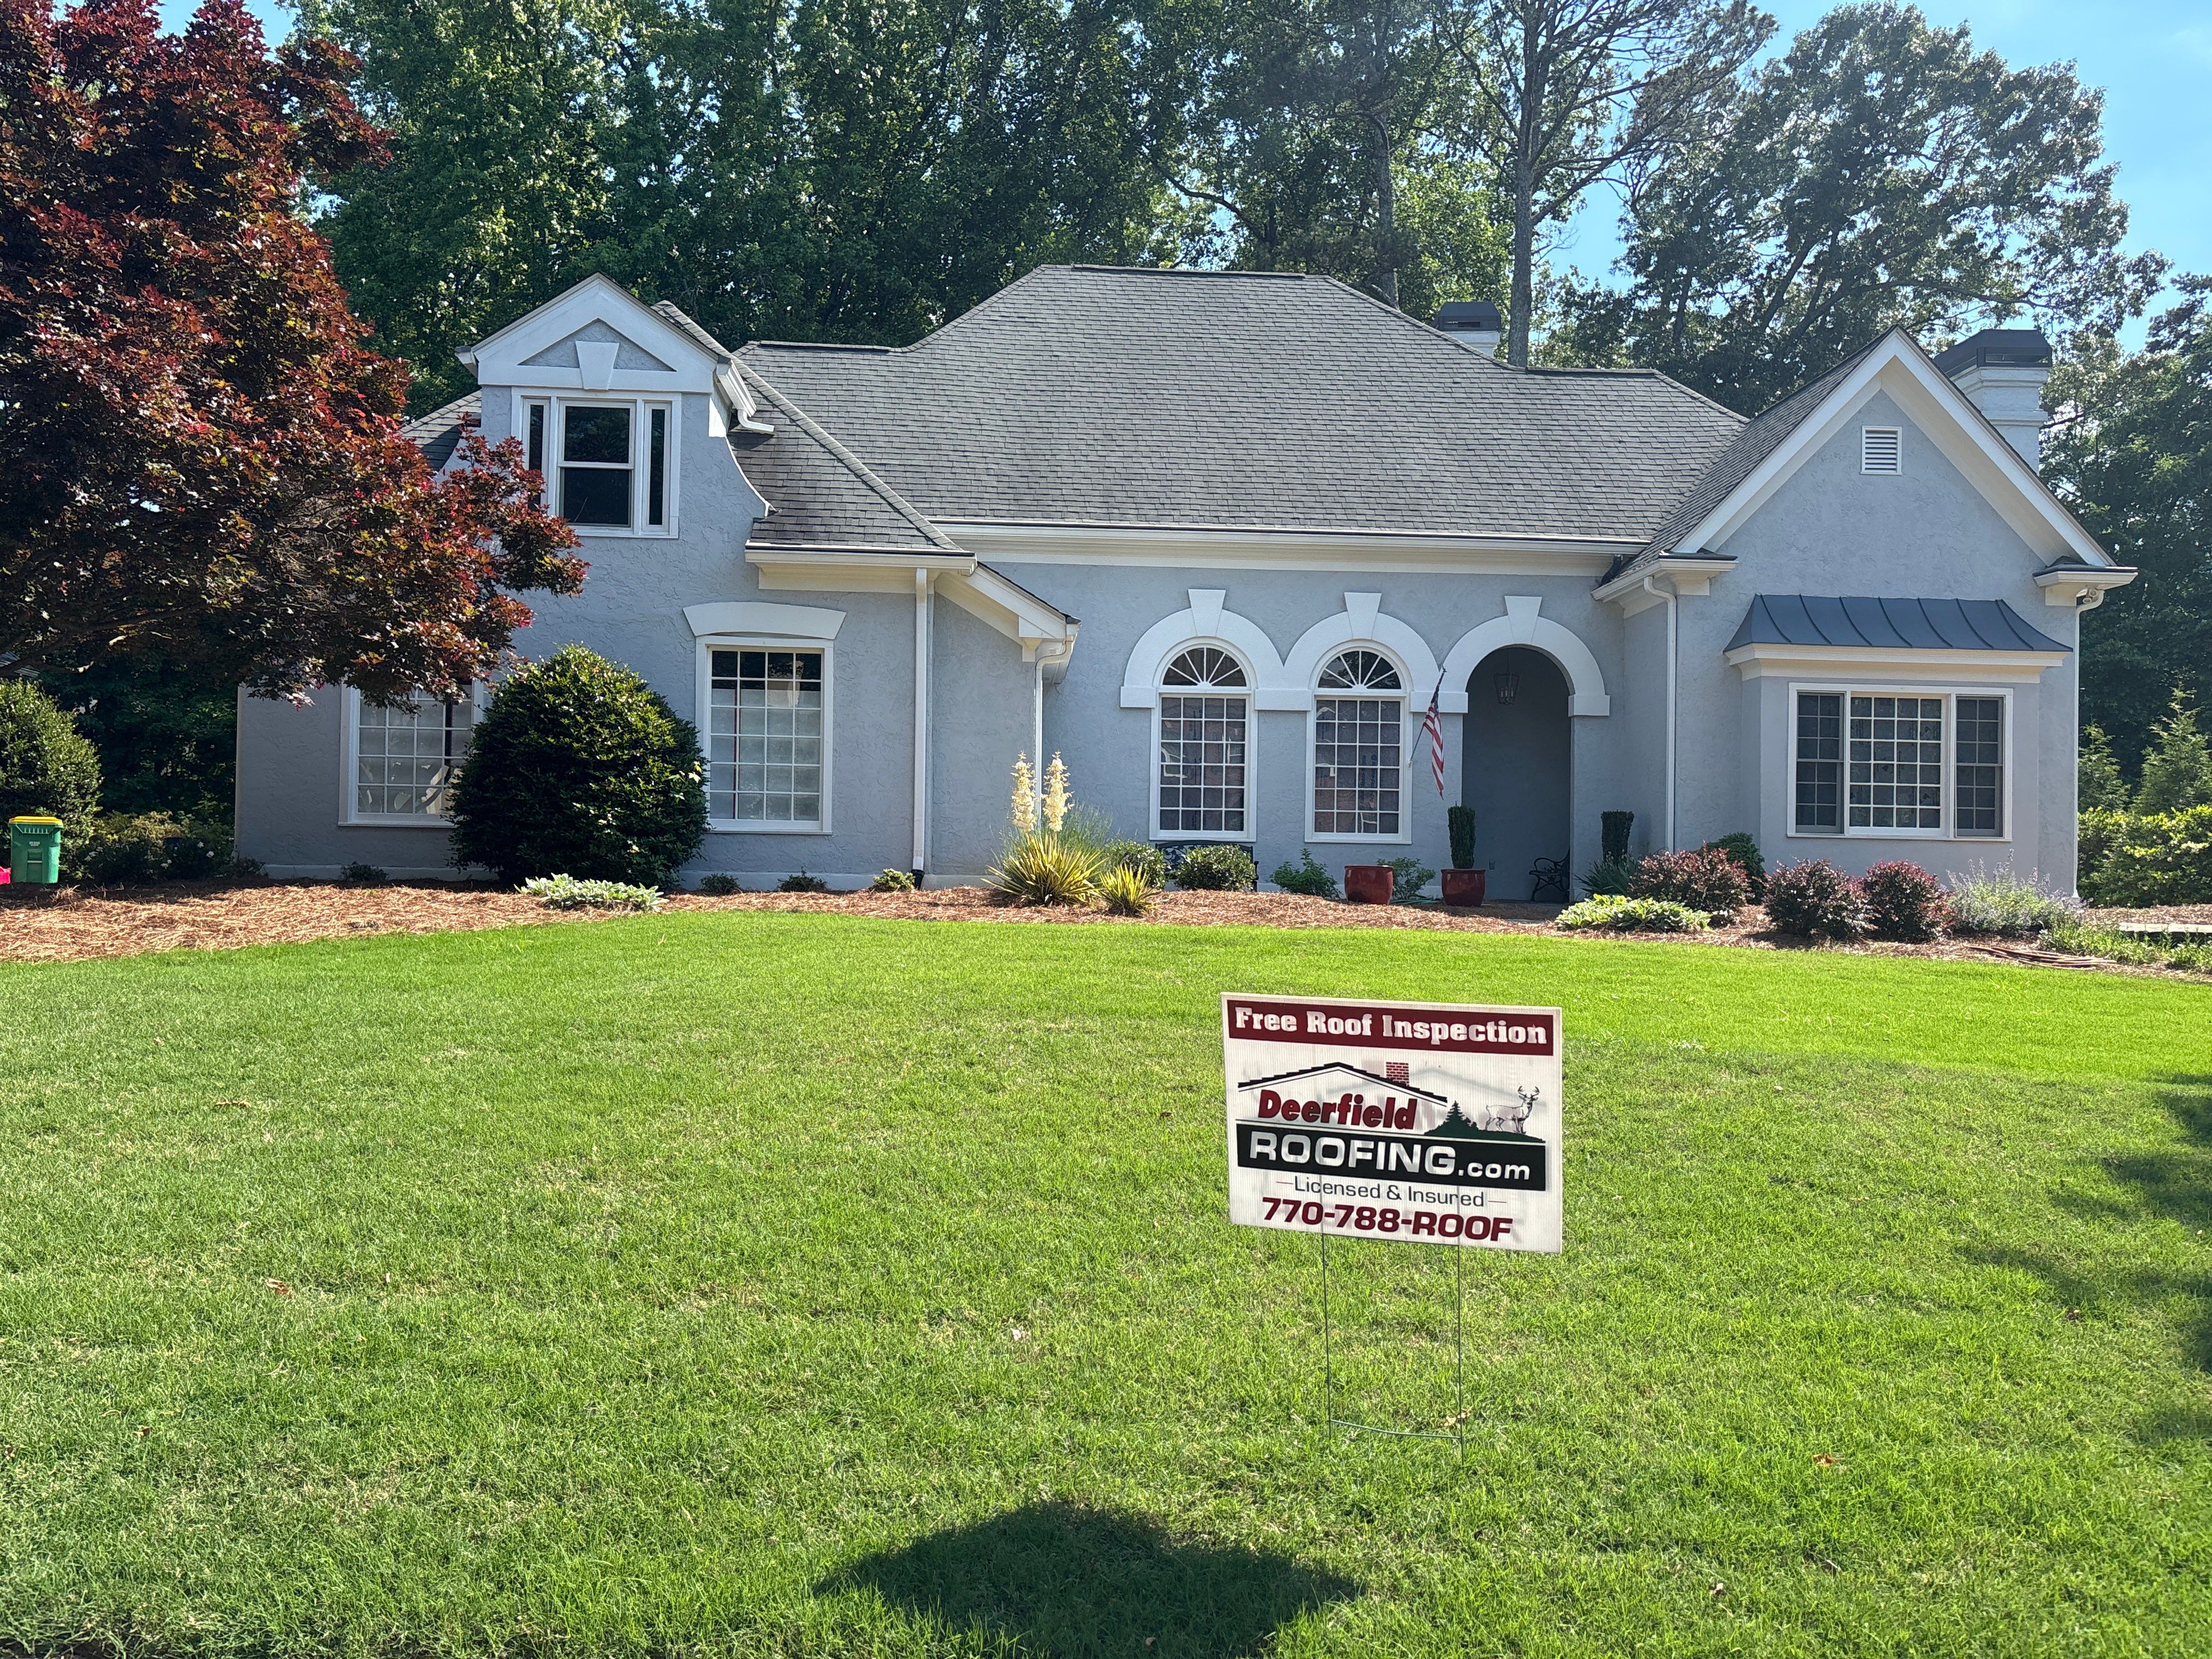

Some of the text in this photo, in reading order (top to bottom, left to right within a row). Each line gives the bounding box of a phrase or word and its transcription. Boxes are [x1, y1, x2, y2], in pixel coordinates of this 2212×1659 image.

[1235, 1007, 1548, 1045] Free Roof Inspection
[1258, 1089, 1418, 1130] Deerfield
[1249, 1131, 1531, 1181] ROOFING.com
[1294, 1176, 1484, 1207] Licensed & Insured
[1261, 1197, 1513, 1242] 770-788-ROOF
